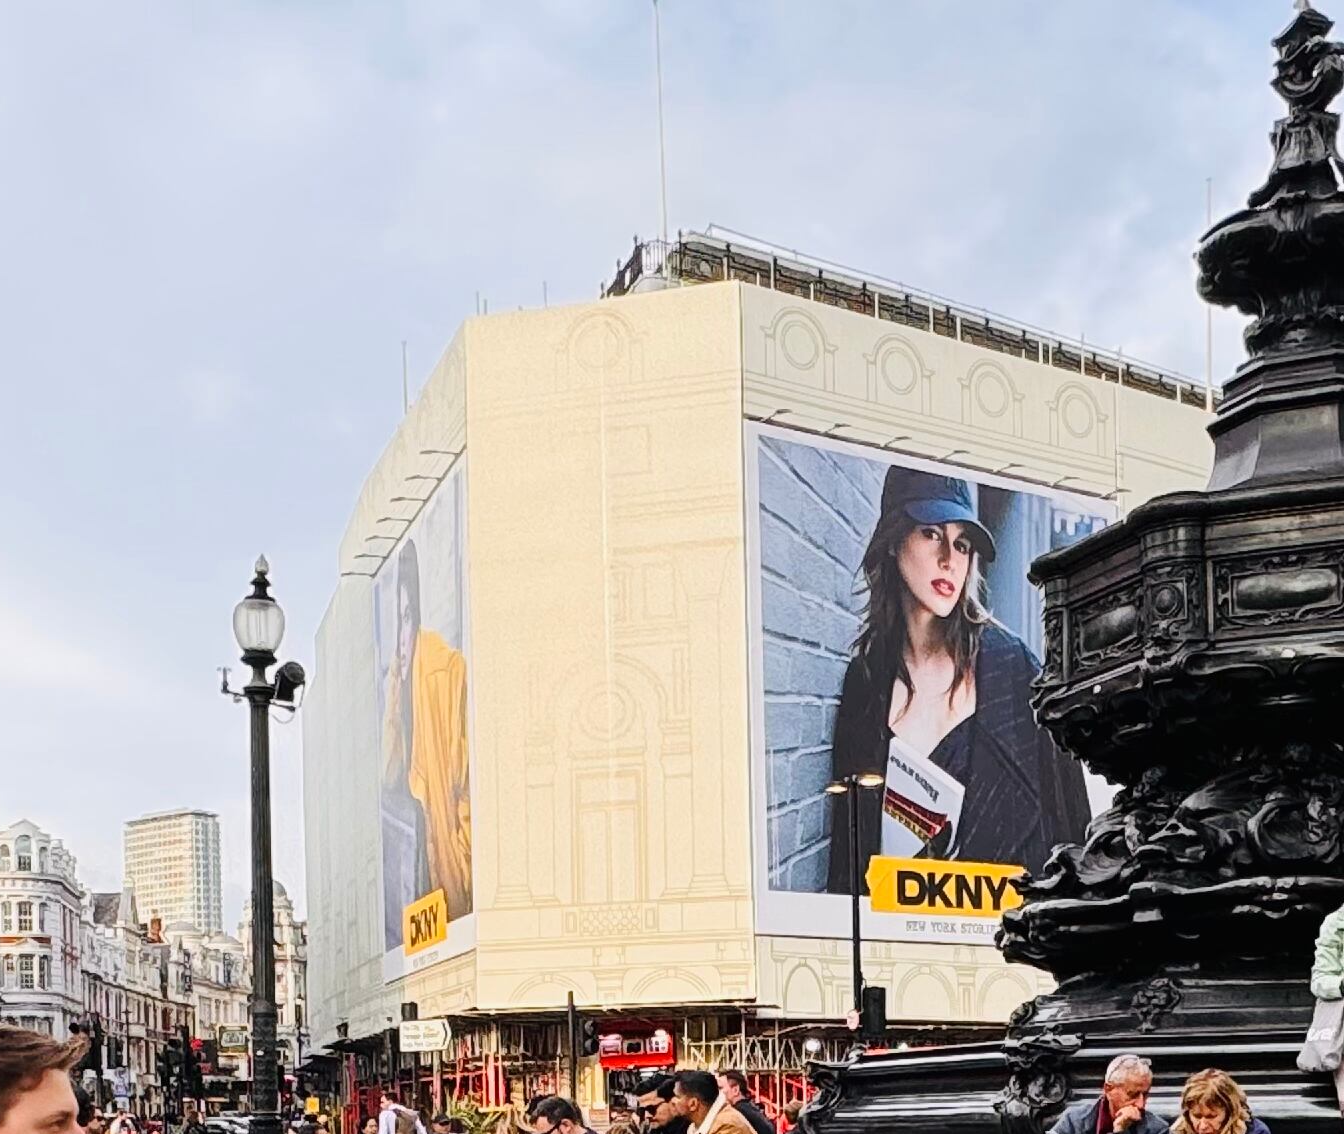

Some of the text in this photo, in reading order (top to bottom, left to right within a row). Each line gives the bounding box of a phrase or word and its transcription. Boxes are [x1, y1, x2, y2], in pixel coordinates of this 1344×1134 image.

[897, 870, 1009, 911] DKNY
[410, 901, 439, 948] DKNY
[906, 920, 997, 936] NEW YORK STORIE
